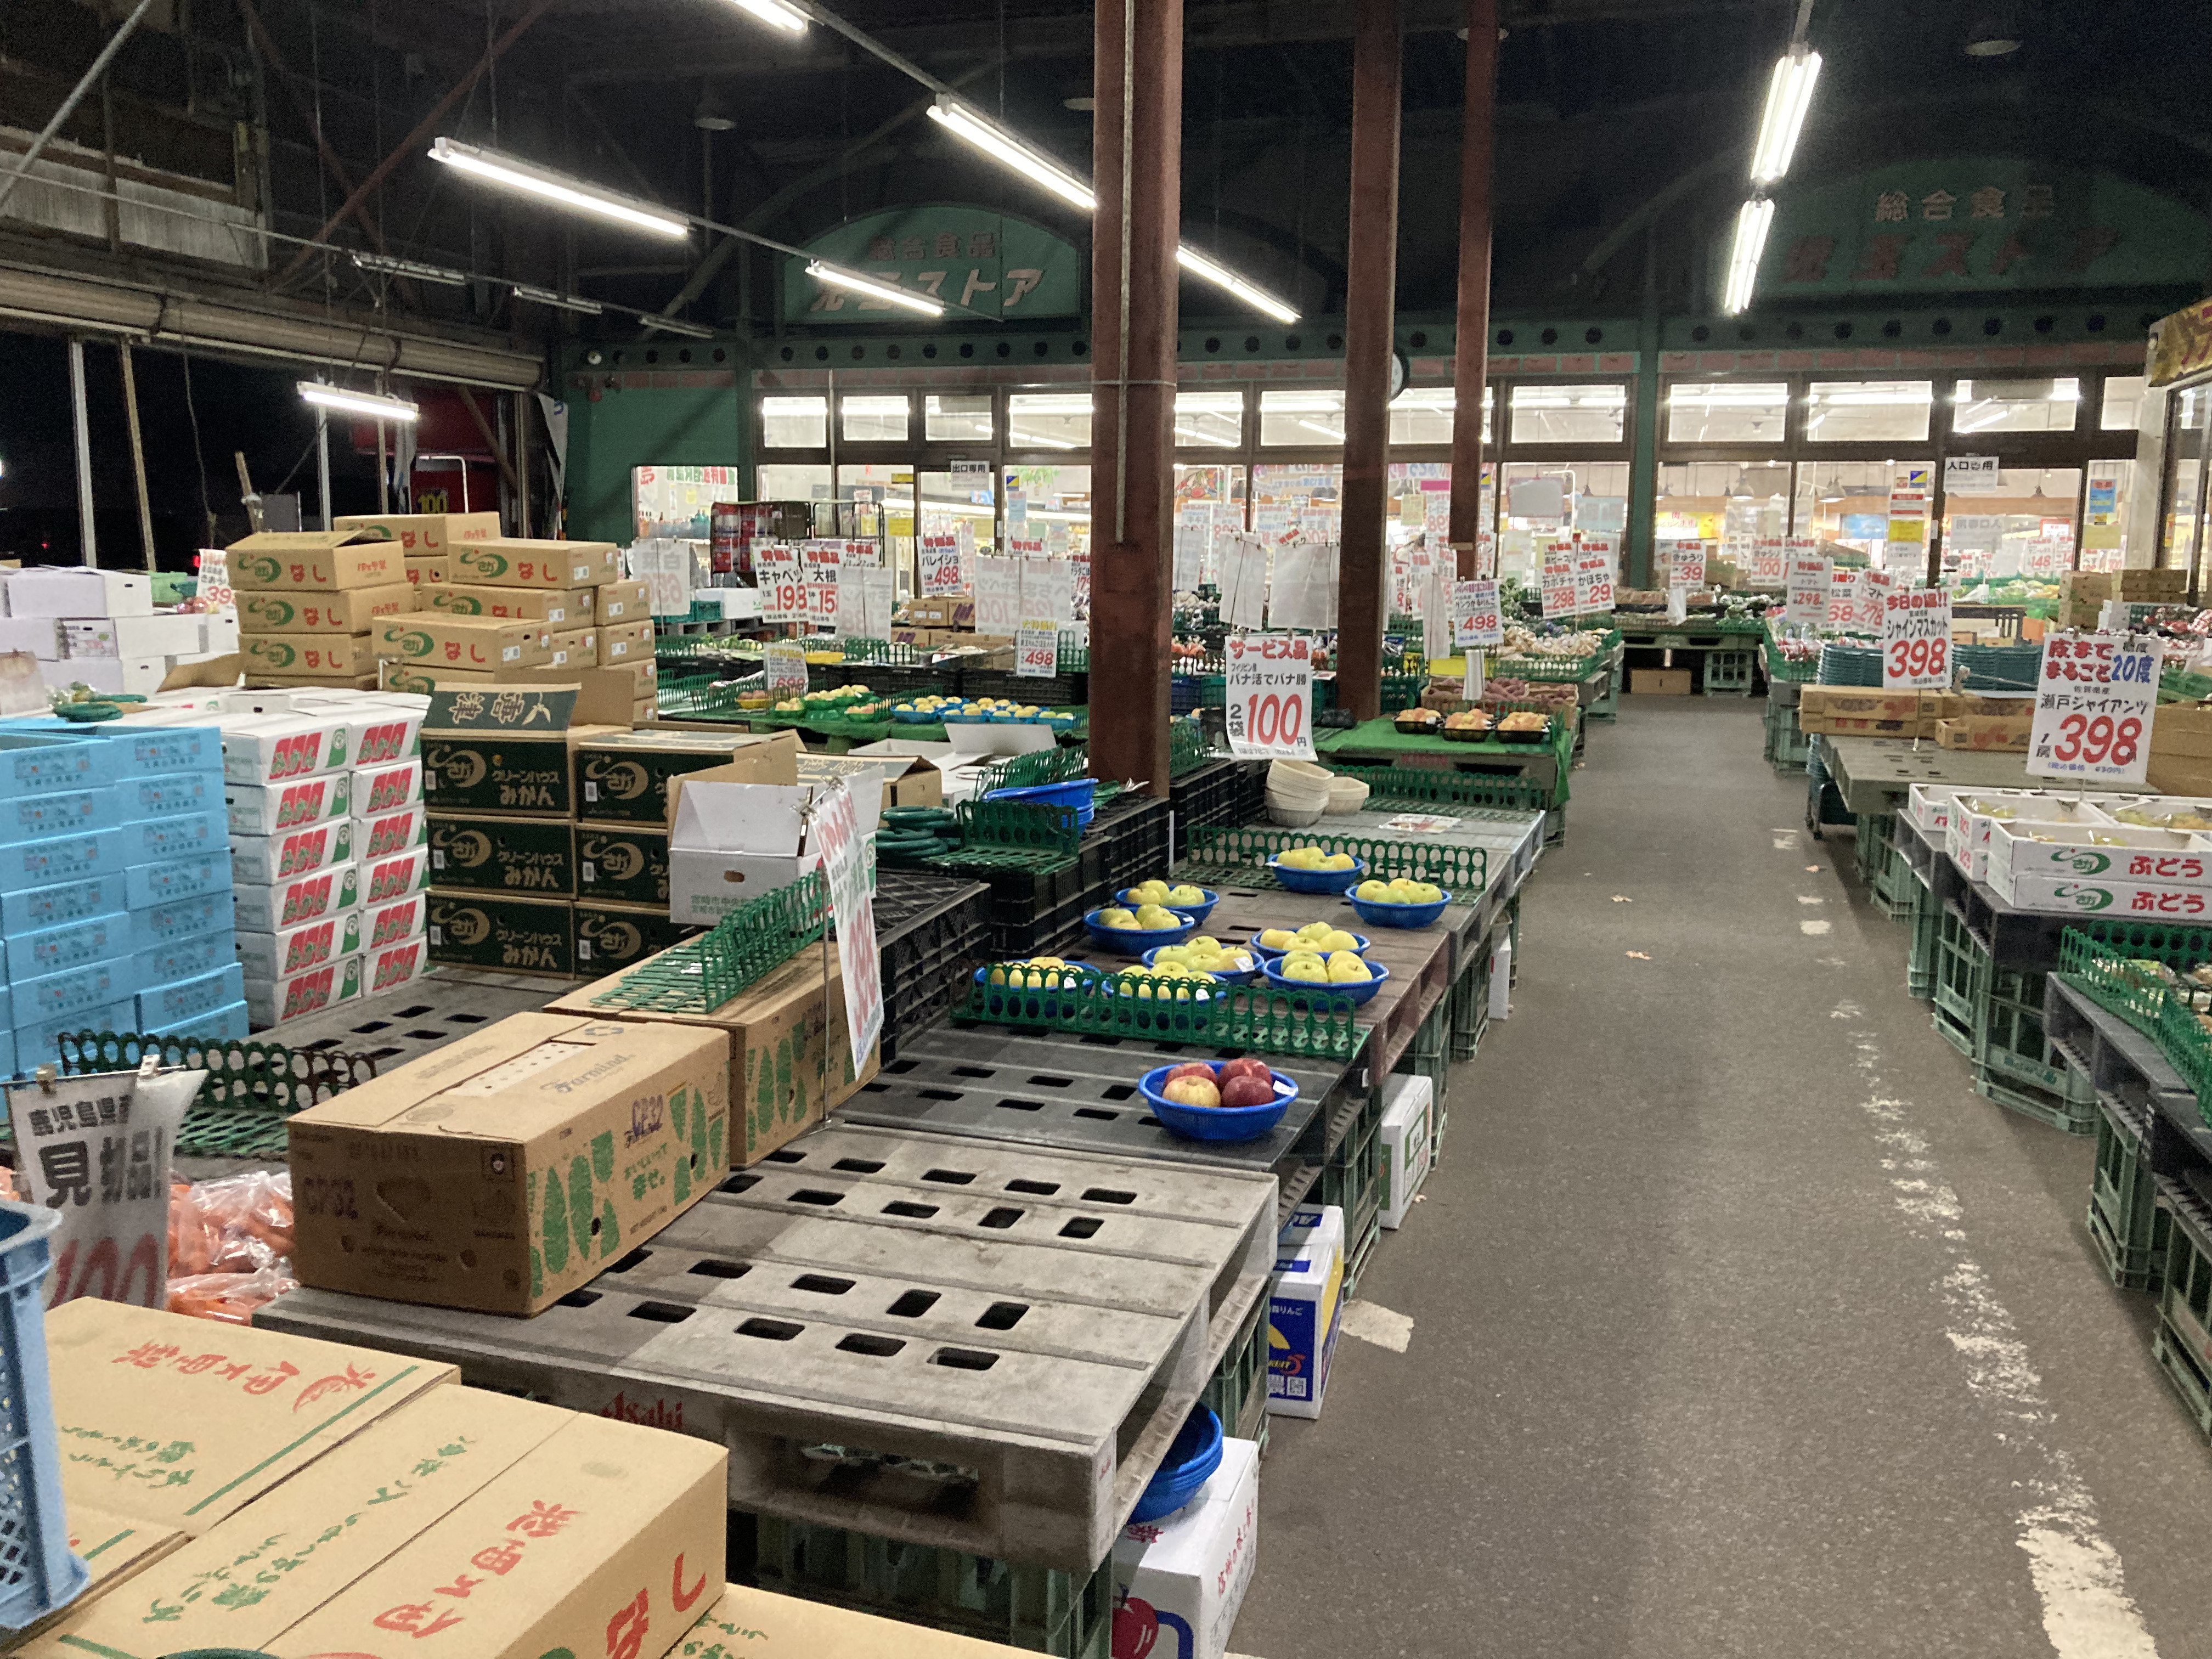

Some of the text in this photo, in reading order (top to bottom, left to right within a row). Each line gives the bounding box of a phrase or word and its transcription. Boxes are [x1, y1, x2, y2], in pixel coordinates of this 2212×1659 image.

[952, 464, 986, 473] 出口専用
[400, 530, 438, 549] なし
[290, 563, 327, 583] なし
[517, 561, 557, 582] なし
[813, 569, 837, 583] 大根
[934, 566, 958, 585] 498
[1578, 573, 1610, 586] かぼちゃ
[1680, 566, 1703, 581] 39
[1542, 577, 1574, 589] カボチャ
[1589, 583, 1611, 604] 29
[207, 585, 233, 604] 39
[776, 584, 808, 612] 198
[1553, 590, 1576, 610] 298
[303, 607, 343, 627] なし
[1463, 614, 1497, 630] 498
[1888, 615, 1948, 639] シャインマスカット
[304, 650, 343, 669] なし
[444, 641, 486, 663] なし
[1024, 649, 1054, 665] 498
[1229, 639, 1308, 660] サービス品
[1887, 637, 1947, 678] 398
[2048, 637, 2114, 661] 皮まで
[1229, 673, 1307, 686] バナ活でバナ勝
[2046, 654, 2155, 684] まるごと 20度
[2040, 693, 2149, 715] 瀬戸ジャイアンツ
[1247, 693, 1302, 746] 100
[2054, 713, 2143, 766] 398
[500, 785, 555, 808] みかん
[496, 850, 565, 867] グリーンハウス
[2129, 854, 2204, 878] ぶどう
[503, 865, 560, 889] みかん
[2131, 891, 2205, 914] ぶどう
[501, 944, 557, 969] みかん
[606, 1551, 706, 1659] なし
